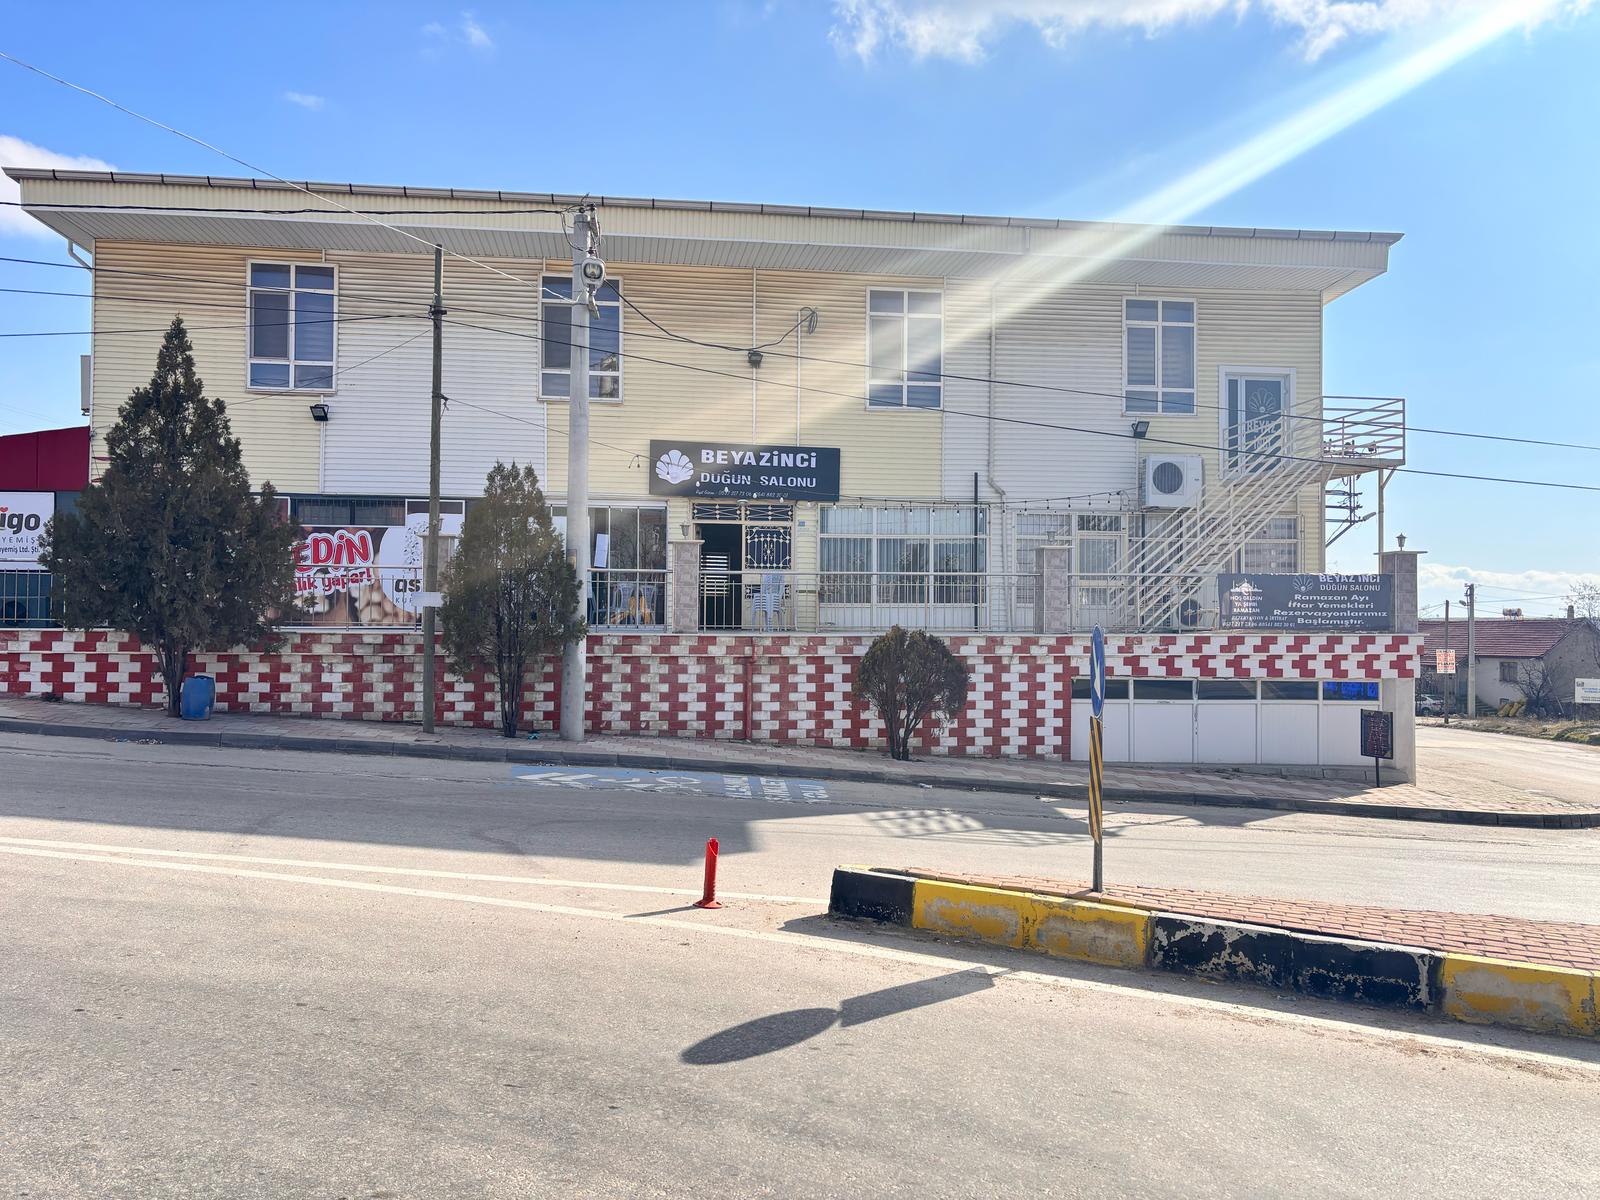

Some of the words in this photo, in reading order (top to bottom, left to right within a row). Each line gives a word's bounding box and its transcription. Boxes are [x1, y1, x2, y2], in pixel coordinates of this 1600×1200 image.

[760, 475, 817, 488] SALONU
[1350, 584, 1380, 592] SALONU
[1350, 594, 1369, 602] Ayı
[1288, 601, 1315, 609] İftar
[1273, 609, 1388, 618] Rezervasyonlarımız
[1297, 618, 1364, 626] Başlamıştır.
